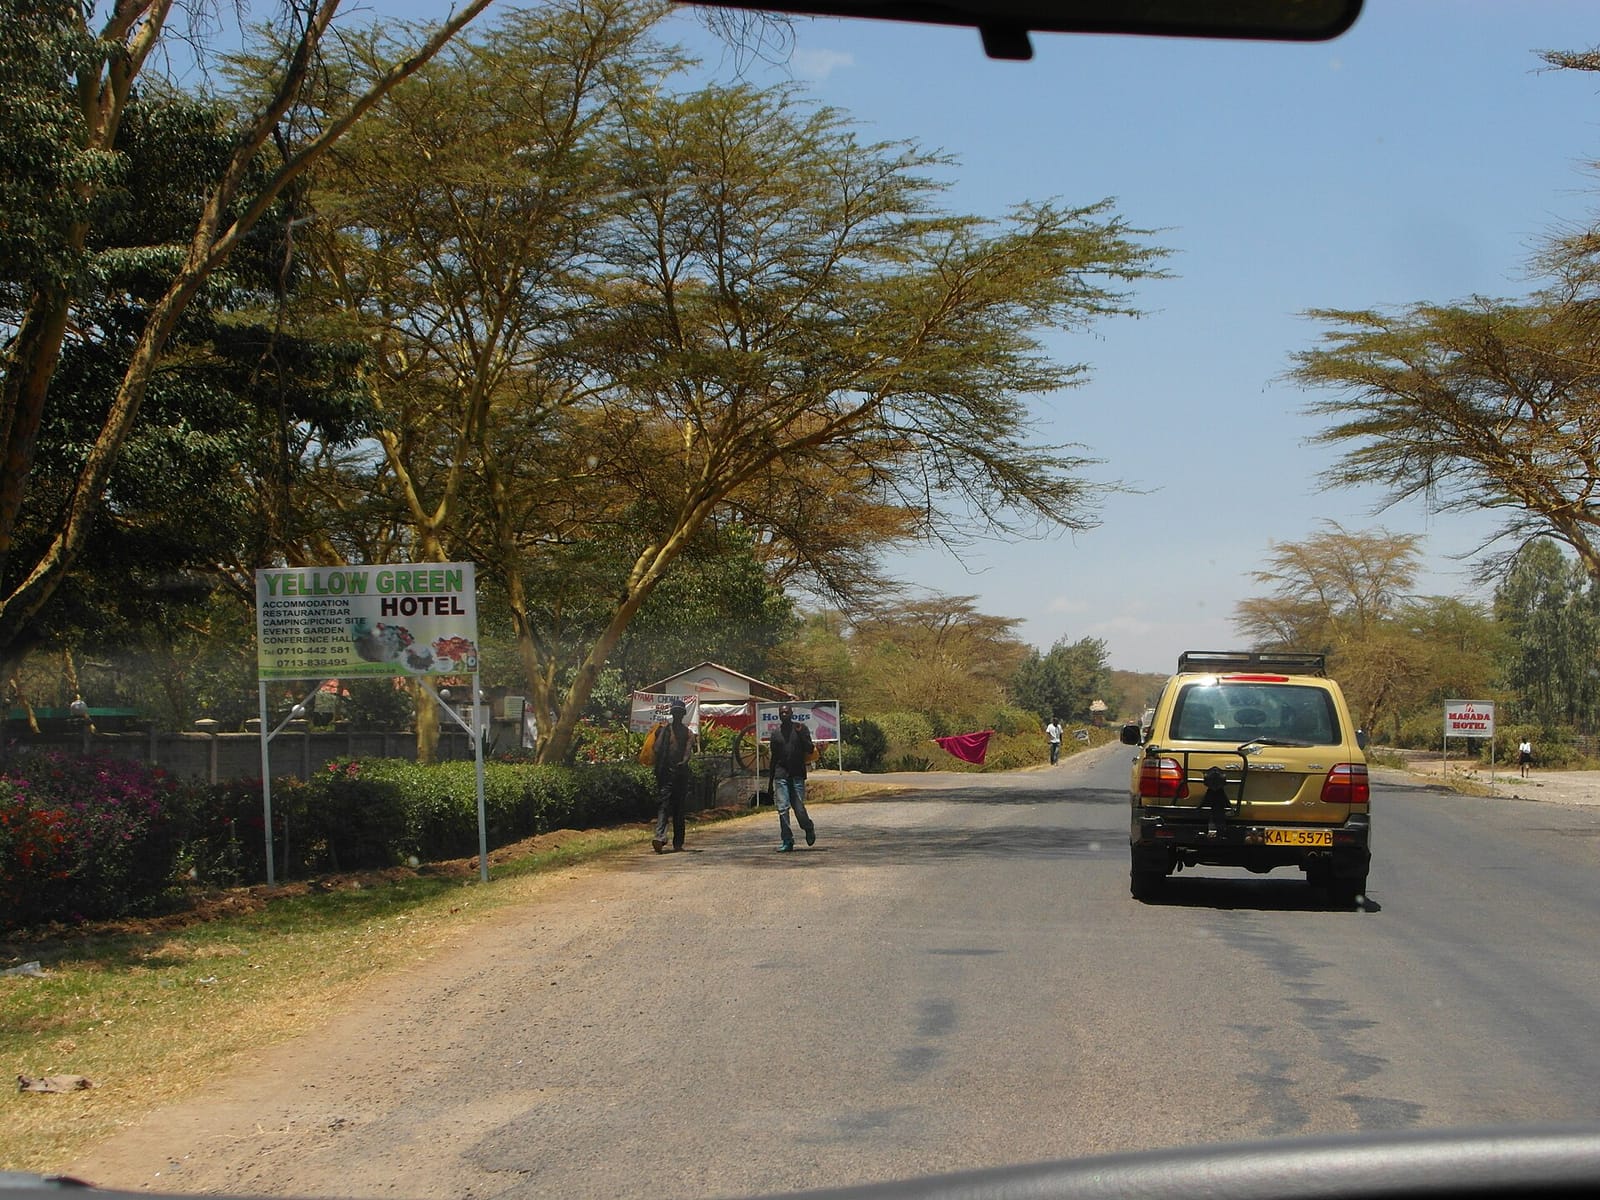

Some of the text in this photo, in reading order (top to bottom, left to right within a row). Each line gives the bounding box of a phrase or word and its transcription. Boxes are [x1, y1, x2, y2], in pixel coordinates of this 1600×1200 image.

[264, 569, 463, 596] YELLOW GREEN
[263, 599, 349, 609] ACCOMMODATION
[381, 597, 465, 617] HOTEL
[263, 609, 351, 617] RESTAURANT/BAR
[263, 617, 367, 626] CAMPING/PICNIC SITE
[263, 627, 300, 635] EVENTS
[263, 635, 356, 644] CONFERENCE HALL
[277, 647, 327, 655] 0710-442
[762, 713, 779, 721] Ho
[1448, 713, 1491, 721] MASADA
[1452, 722, 1487, 730] HOTEL
[1265, 831, 1332, 845] KAL 557B
